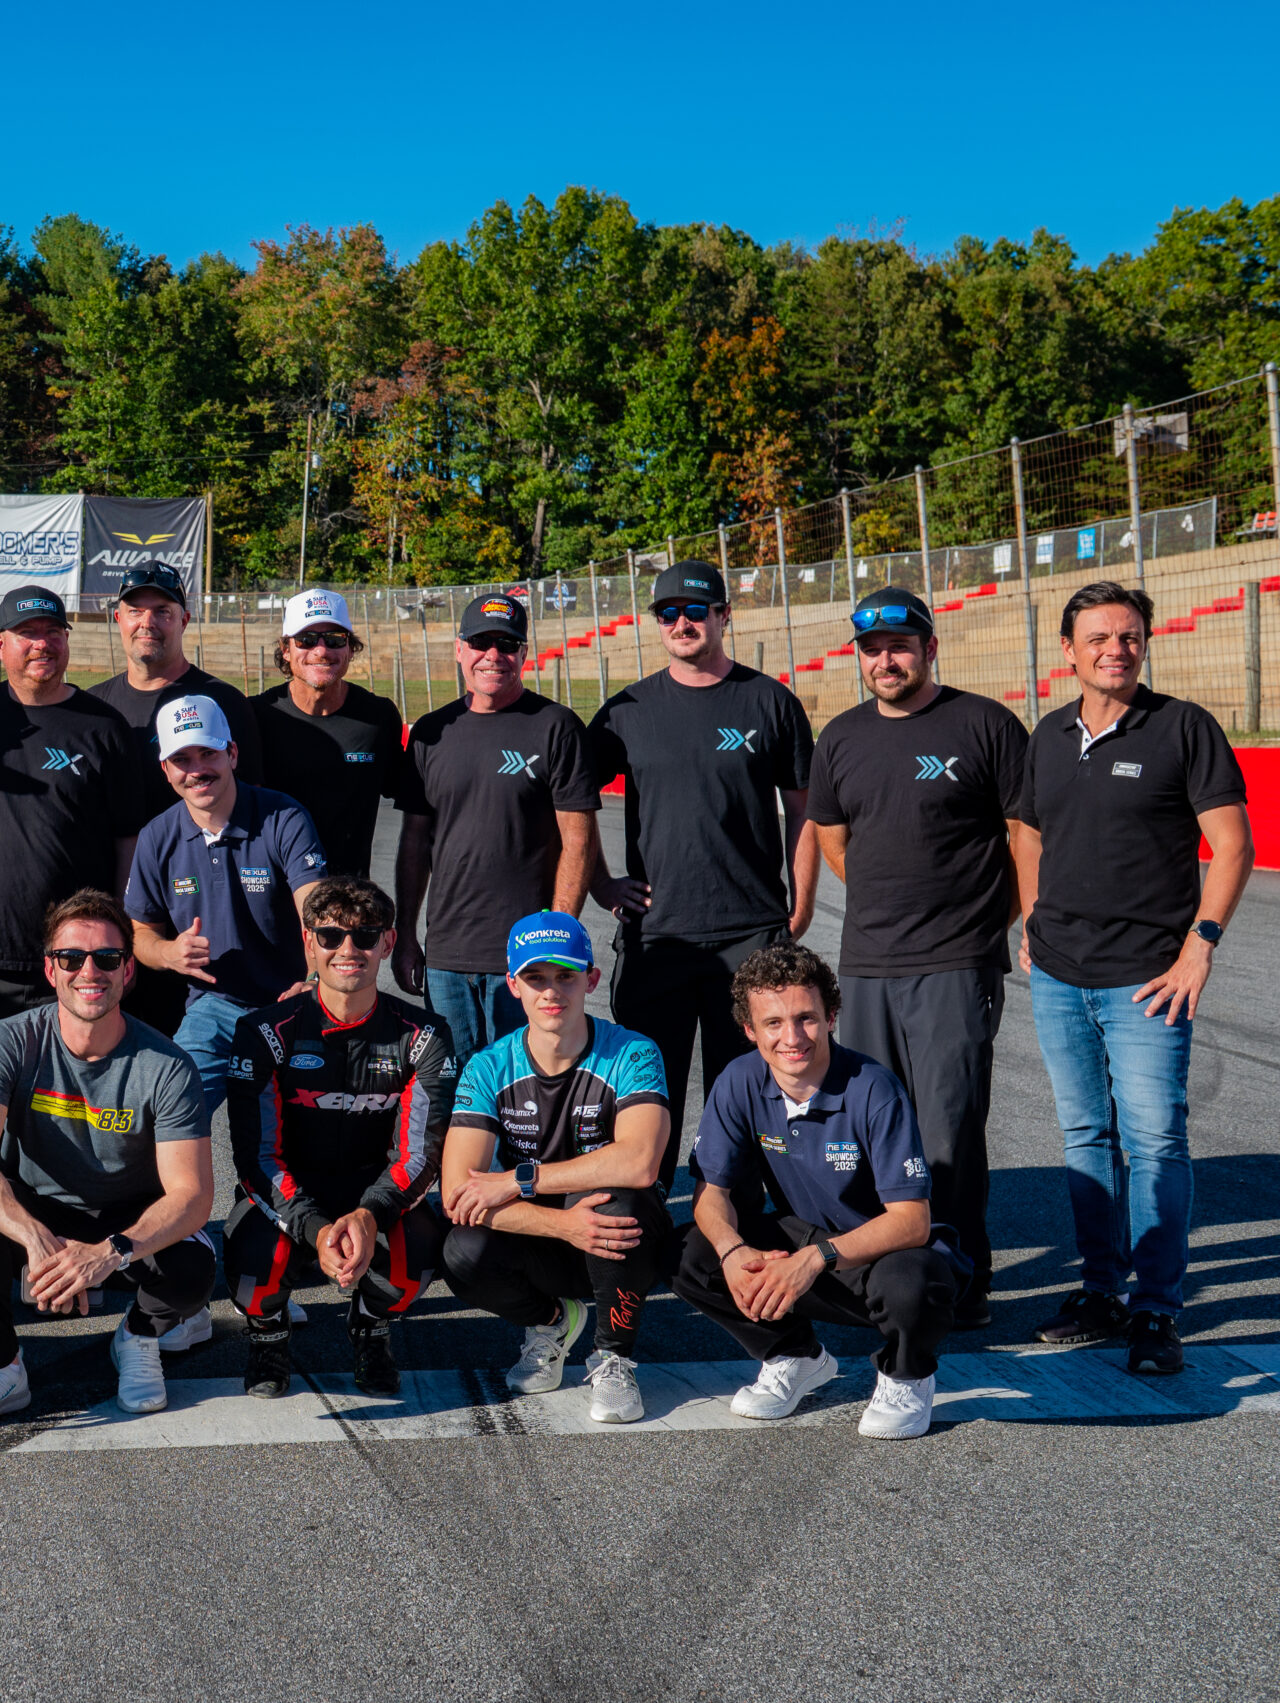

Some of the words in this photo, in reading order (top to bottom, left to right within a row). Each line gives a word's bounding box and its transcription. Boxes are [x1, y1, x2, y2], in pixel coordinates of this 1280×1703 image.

[31, 556, 63, 566] PUMP
[87, 549, 196, 568] ALLIANCE
[180, 704, 198, 713] surf
[181, 711, 199, 719] USA
[240, 876, 271, 885] SHOWCASE
[246, 884, 265, 893] 2025
[259, 1023, 285, 1065] sparco
[229, 1055, 253, 1072] SG
[294, 1056, 317, 1066] Ford
[97, 1108, 134, 1133] 83
[834, 1161, 858, 1171] 2025
[610, 1287, 640, 1332] Paris
